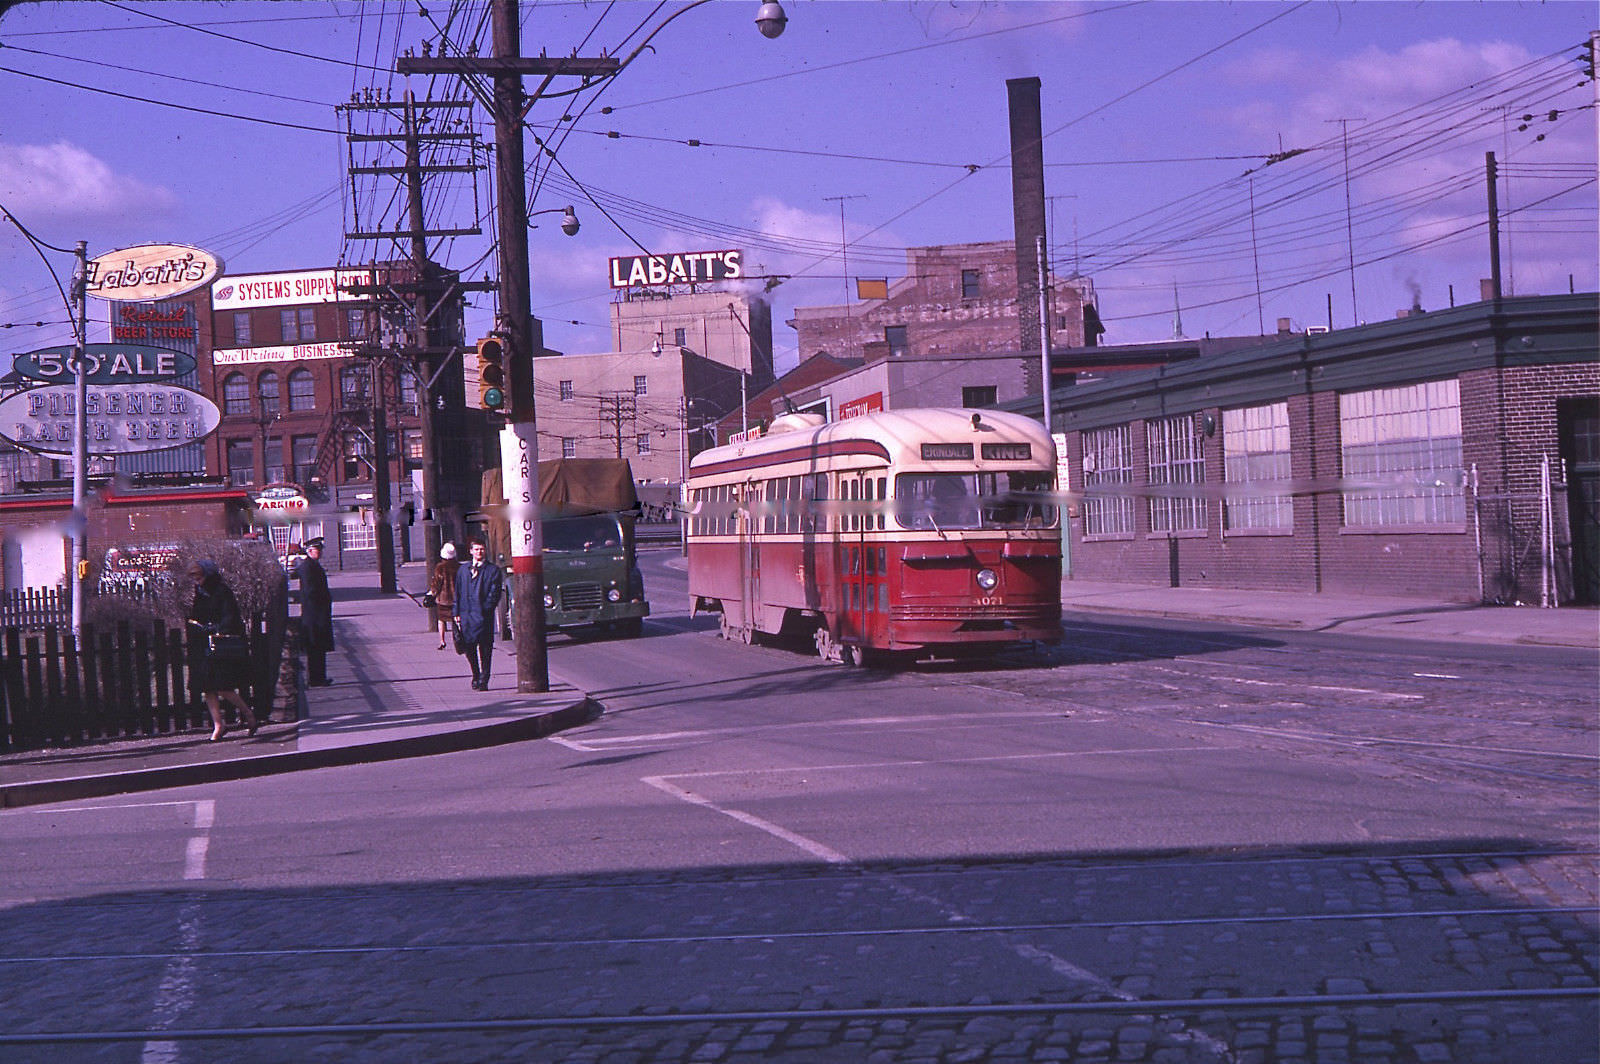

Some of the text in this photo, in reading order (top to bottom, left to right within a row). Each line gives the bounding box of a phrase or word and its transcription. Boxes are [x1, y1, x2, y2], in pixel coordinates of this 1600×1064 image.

[86, 253, 206, 291] Labatt's
[612, 251, 740, 286] LABATT'S
[239, 280, 291, 301] SYSTEMS
[295, 277, 337, 297] SUPPLY
[121, 306, 186, 322] Retail
[115, 327, 193, 338] BEER STORE
[110, 353, 176, 375] ALE
[27, 391, 189, 416] PILSENER
[15, 419, 201, 442] LAGR BEER
[983, 448, 1029, 459] KING
[519, 438, 533, 546] CAR SOP
